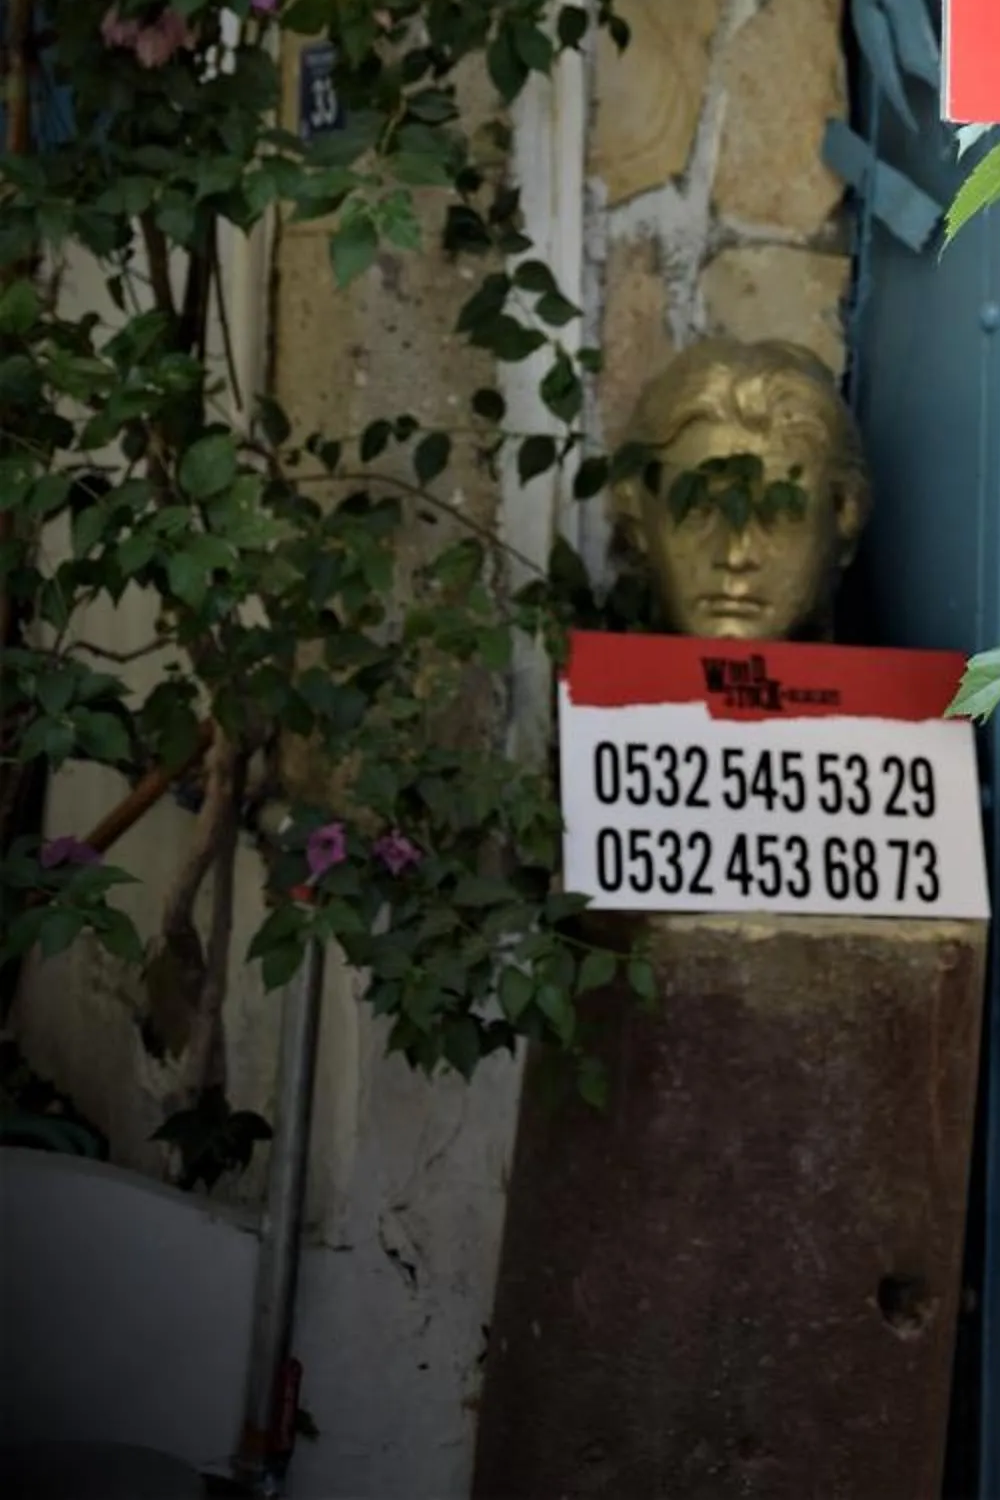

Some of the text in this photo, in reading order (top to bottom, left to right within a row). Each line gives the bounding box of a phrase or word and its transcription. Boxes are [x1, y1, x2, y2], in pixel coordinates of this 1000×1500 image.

[594, 741, 937, 819] 0532 545 53 29
[597, 826, 941, 905] 0532 453 68 73
